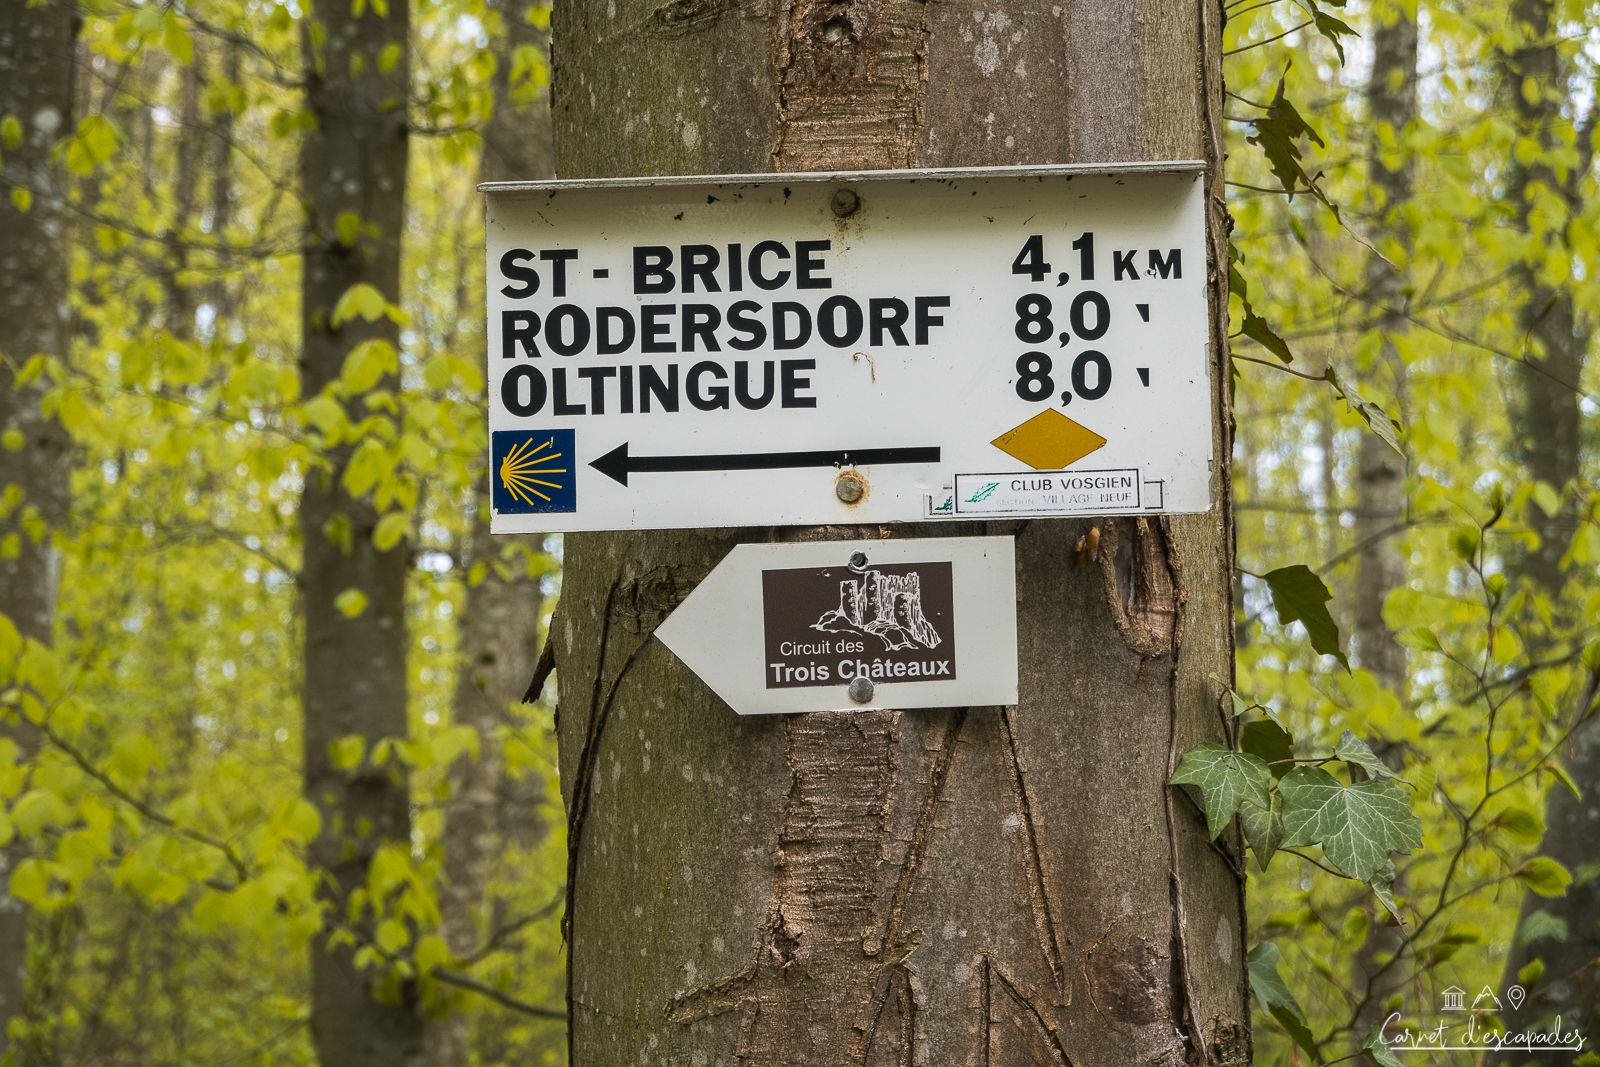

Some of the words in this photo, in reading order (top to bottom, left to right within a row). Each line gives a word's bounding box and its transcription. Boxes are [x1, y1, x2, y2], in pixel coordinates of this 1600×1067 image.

[499, 248, 579, 299] ST
[633, 239, 833, 295] BRICE
[1011, 231, 1095, 288] 4,1
[501, 295, 951, 359] RODERSDORF
[1014, 290, 1111, 349] 8,0
[500, 359, 817, 418] OLTINGUE
[1015, 349, 1112, 408] 8,0
[1010, 478, 1053, 492] CLUB
[1060, 475, 1133, 490] VOSGIEN
[1099, 492, 1133, 503] NEUF
[779, 639, 831, 656] Circuit
[835, 639, 865, 654] des
[770, 661, 830, 683] Trois
[837, 657, 951, 680] Châteaux
